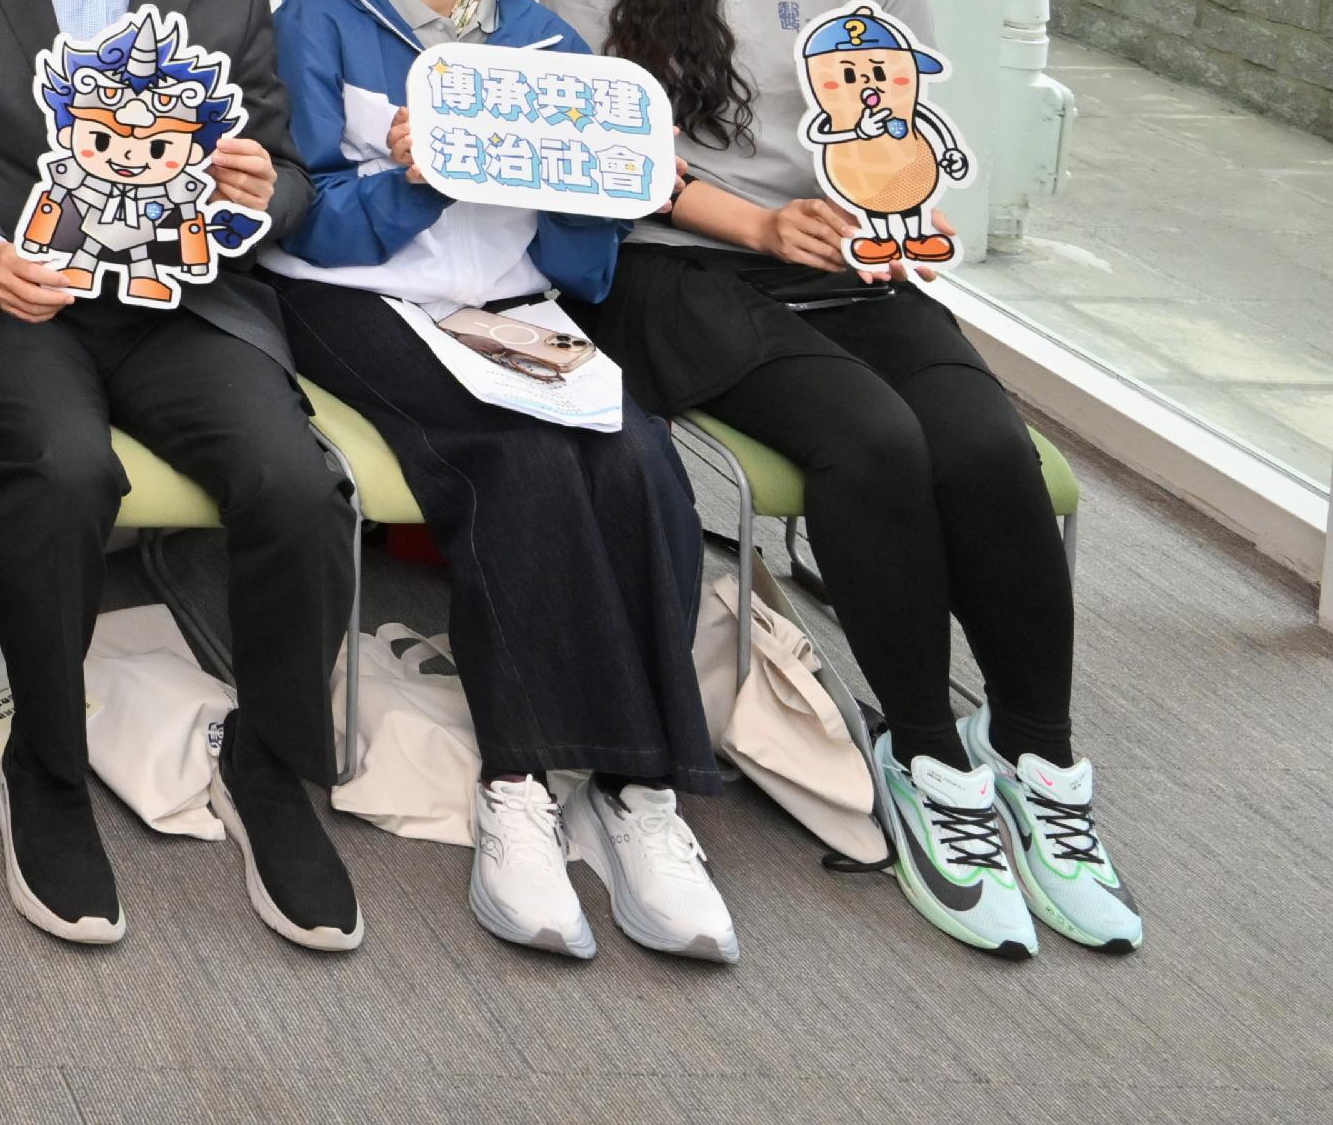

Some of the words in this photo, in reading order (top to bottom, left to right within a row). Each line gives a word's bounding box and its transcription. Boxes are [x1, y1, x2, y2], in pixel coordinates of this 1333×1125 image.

[427, 58, 652, 134] 傳承共建
[429, 127, 654, 201] 法治社會
